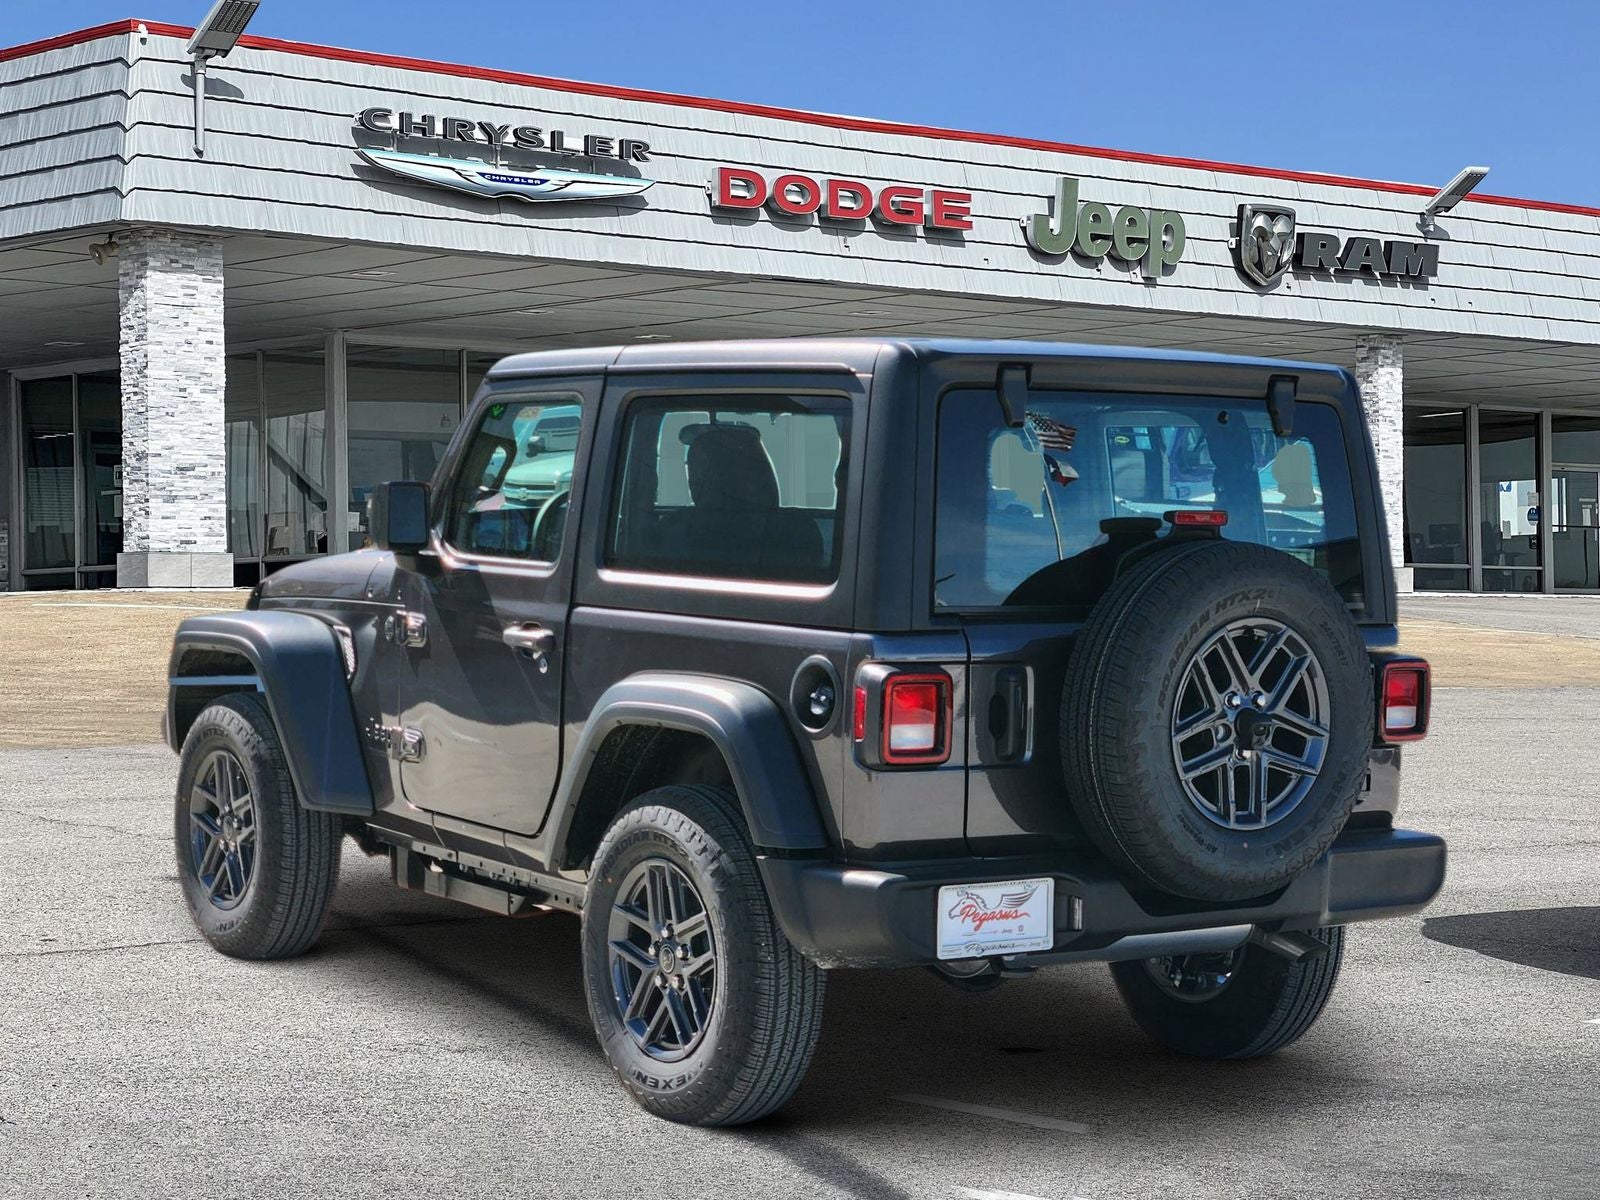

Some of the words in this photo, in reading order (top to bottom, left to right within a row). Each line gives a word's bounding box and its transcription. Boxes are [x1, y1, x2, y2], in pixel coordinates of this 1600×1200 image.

[357, 106, 651, 162] CHRYSLER
[484, 173, 542, 185] CHRYSLER
[711, 166, 974, 231] DODGE
[1026, 176, 1186, 279] Jeep
[1300, 231, 1440, 278] RAM
[959, 904, 1031, 932] Pegasus
